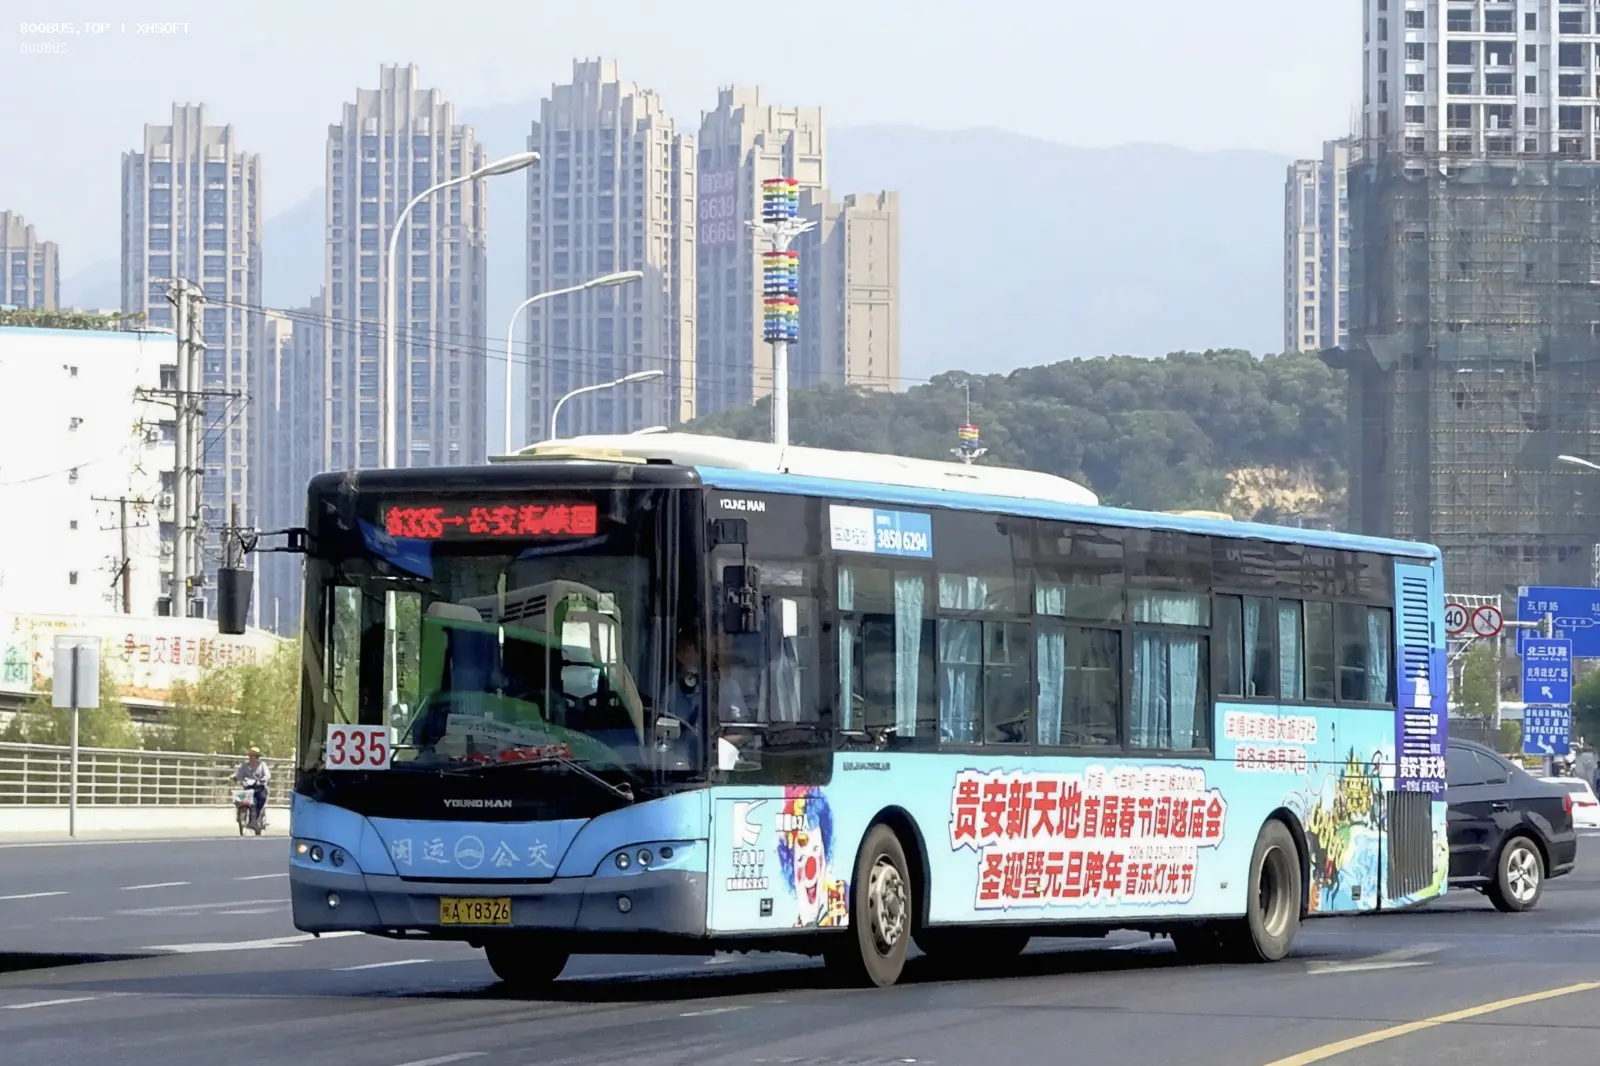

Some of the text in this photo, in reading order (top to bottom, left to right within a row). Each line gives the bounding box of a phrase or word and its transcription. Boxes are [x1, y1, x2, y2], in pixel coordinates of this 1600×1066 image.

[1445, 611, 1463, 625] 40
[329, 731, 386, 766] 335
[954, 779, 1223, 841] 贵安新天地 首届春节闽越庙会
[391, 839, 554, 868] 闽运 公交
[980, 851, 1194, 900] 圣诞暨元旦跨年 音乐灯光节
